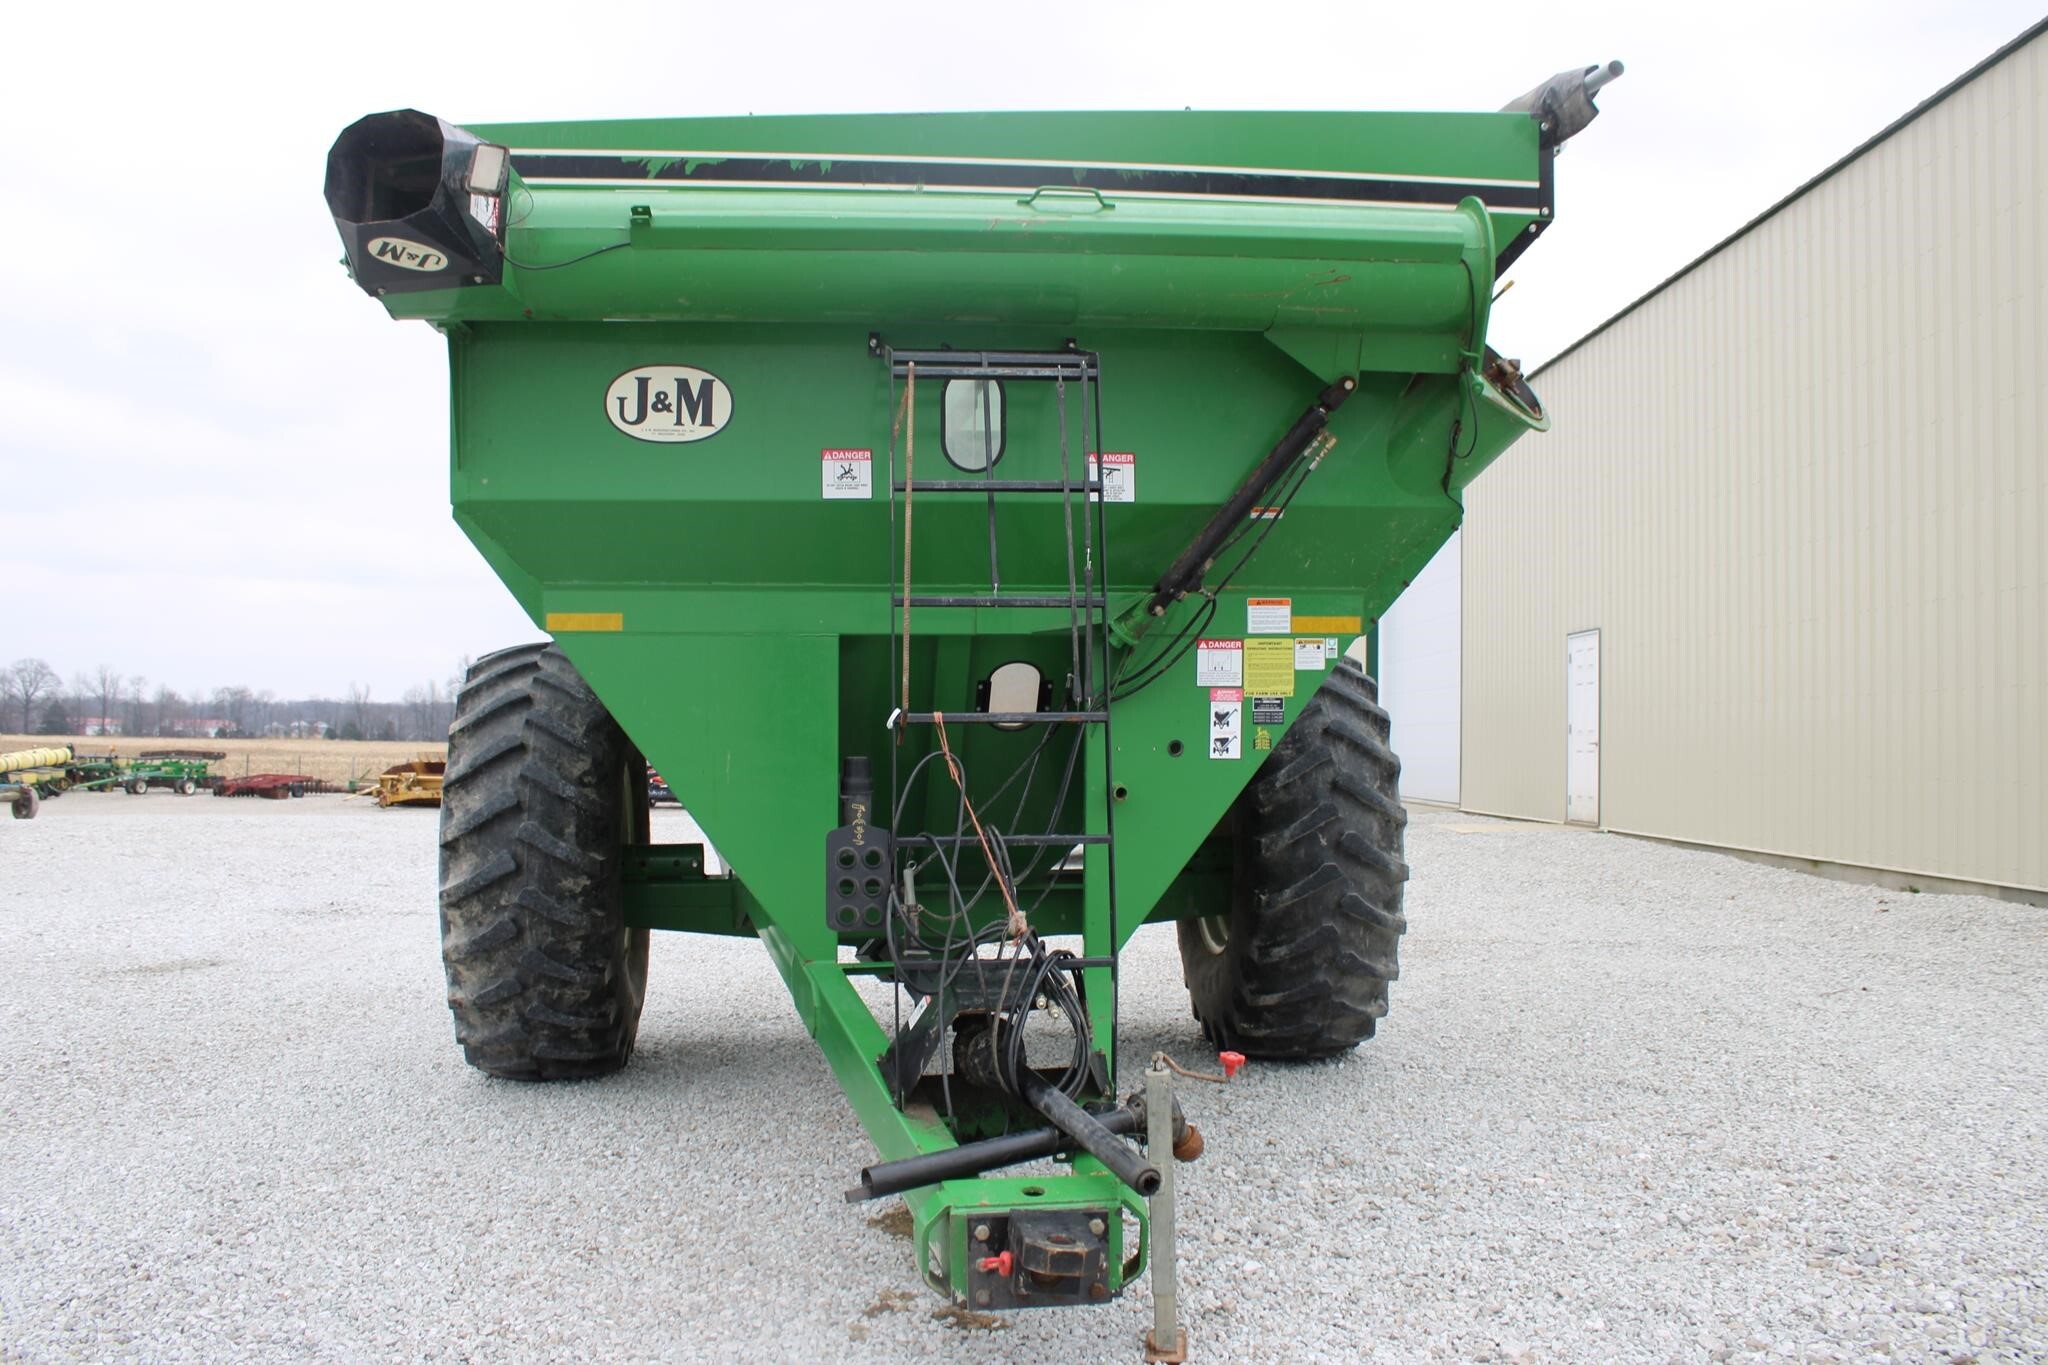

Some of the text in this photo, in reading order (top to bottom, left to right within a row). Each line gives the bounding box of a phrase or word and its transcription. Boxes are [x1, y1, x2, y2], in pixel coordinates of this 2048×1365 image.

[376, 241, 442, 268] J&M
[616, 376, 716, 427] J&M
[832, 451, 871, 459] DANGER
[1102, 454, 1133, 462] ANGER
